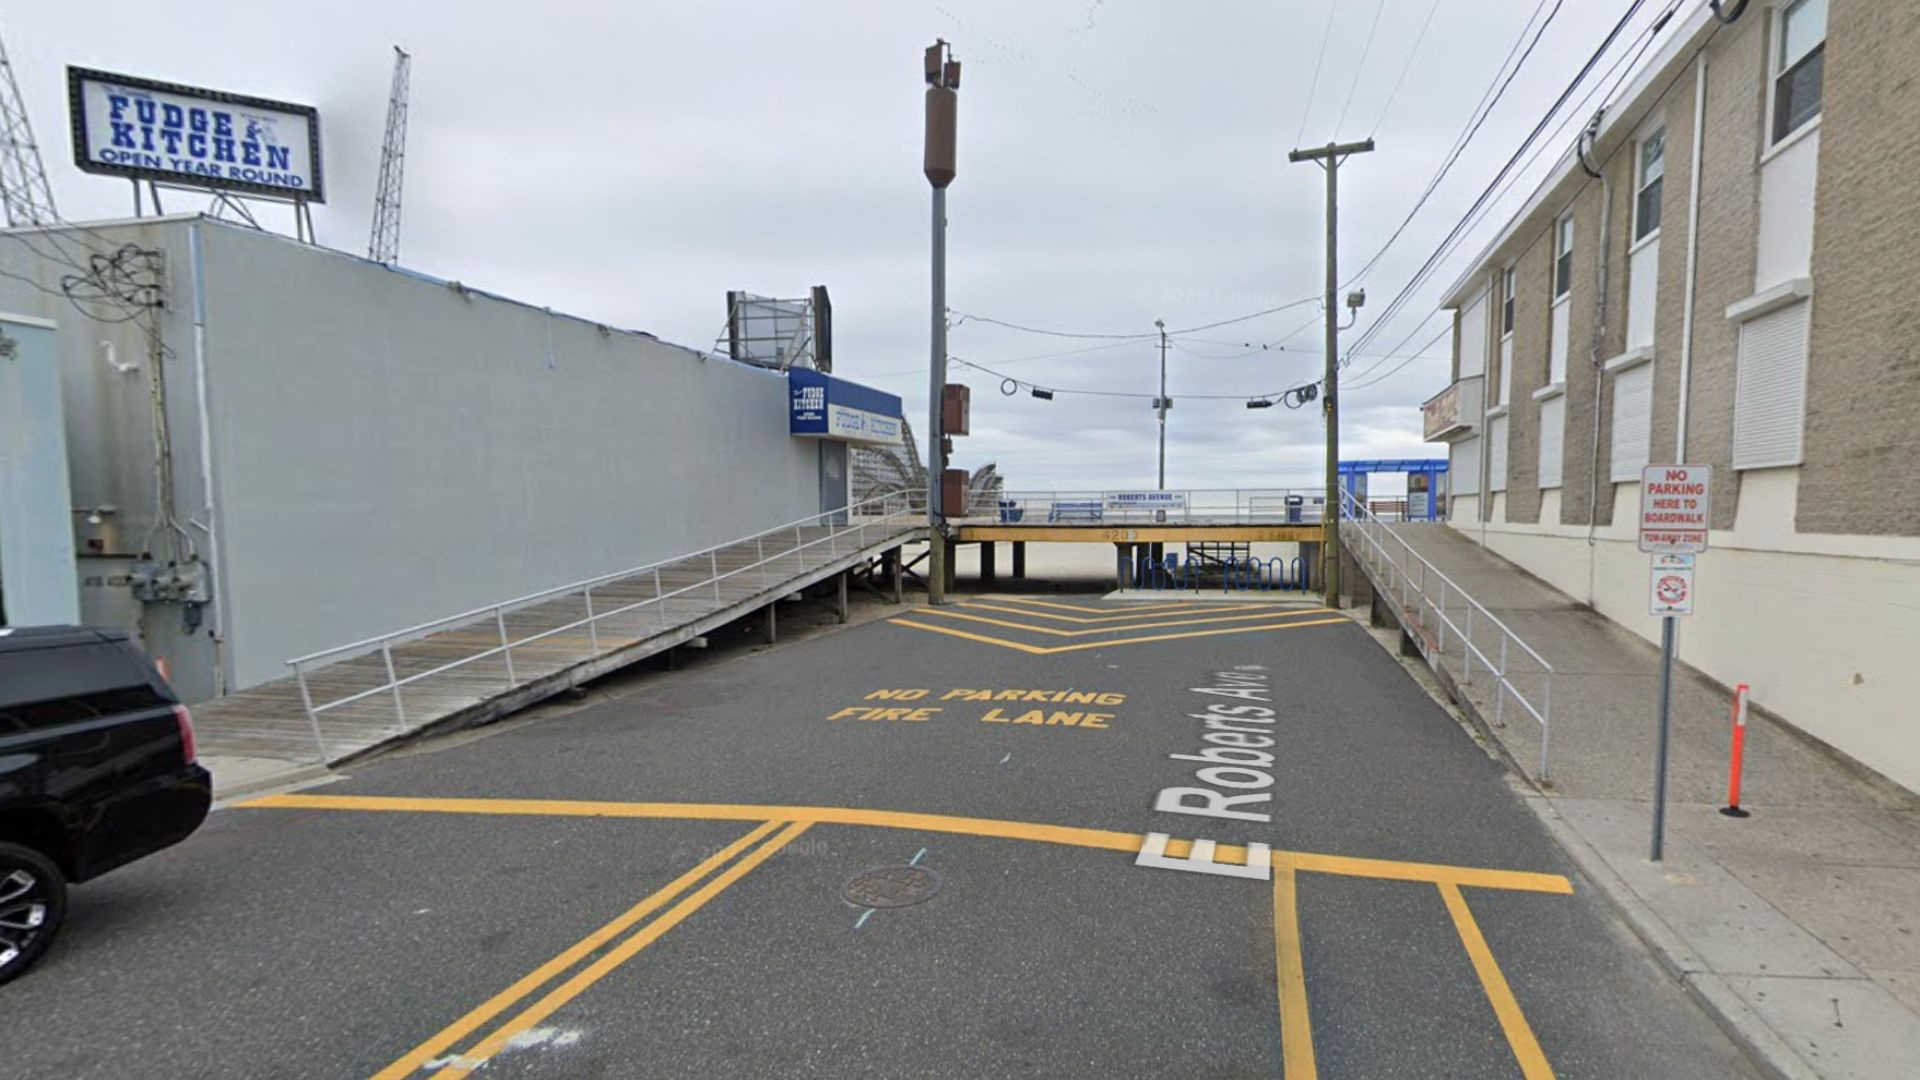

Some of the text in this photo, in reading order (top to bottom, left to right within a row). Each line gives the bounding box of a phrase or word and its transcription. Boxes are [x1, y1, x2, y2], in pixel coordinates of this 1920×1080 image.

[108, 95, 233, 137] FUDGE
[111, 122, 291, 170] KITCHEN
[99, 148, 304, 188] OPEN YEAR ROUND
[803, 387, 824, 398] FUDGE
[1665, 470, 1688, 482] NO
[1648, 483, 1705, 495] PARKING
[1118, 493, 1147, 501] ROBERTS
[1149, 493, 1173, 501] AVENUE
[1653, 498, 1698, 509] HERE TO
[1644, 512, 1705, 524] BOARDWALK
[1682, 533, 1703, 543] ZONE
[864, 688, 1127, 706] NO PARKING
[826, 706, 1116, 729] FIRE LANE
